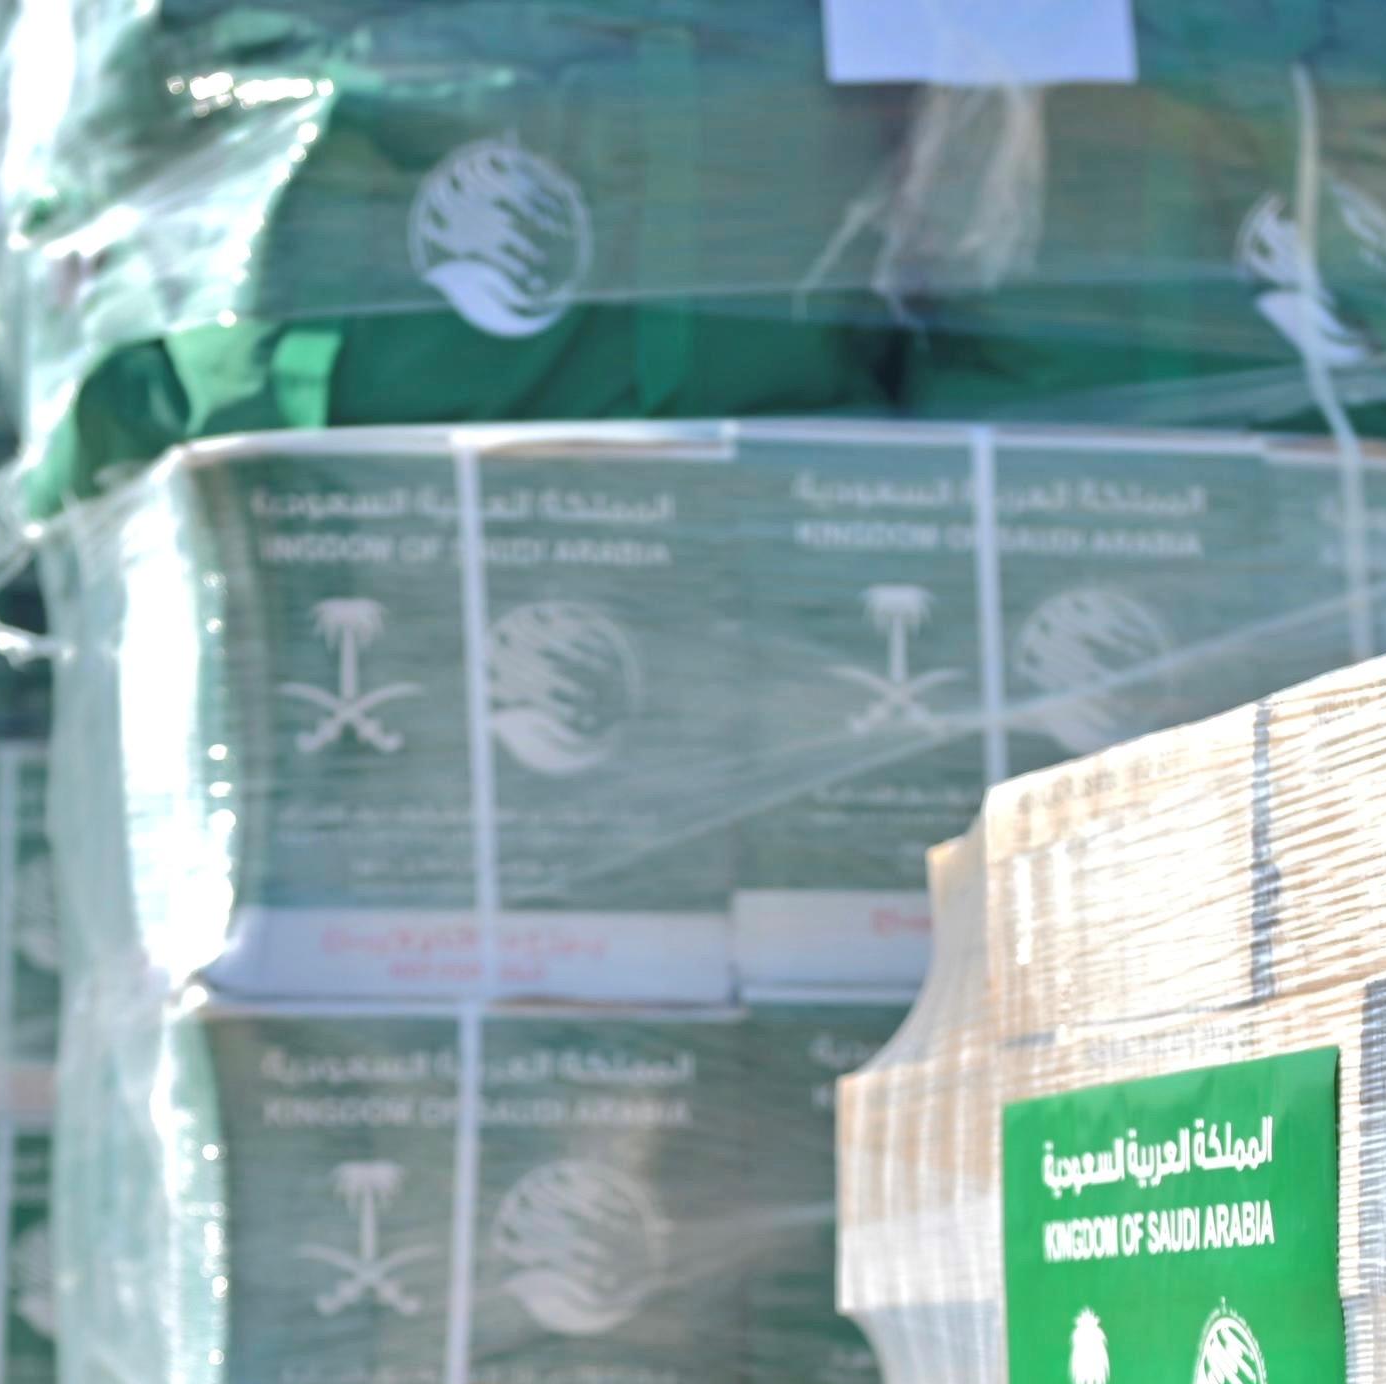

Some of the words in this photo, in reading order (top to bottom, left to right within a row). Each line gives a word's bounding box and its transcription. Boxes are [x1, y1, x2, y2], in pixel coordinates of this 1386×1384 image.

[1041, 1137, 1125, 1198] السعودية
[1126, 1127, 1191, 1189] العربية
[1193, 1115, 1274, 1172] المملكة
[1044, 1215, 1118, 1263] KINGDOM
[1121, 1212, 1144, 1258] OF
[1147, 1206, 1200, 1255] SAUDI
[1203, 1199, 1275, 1249] ARABIA
